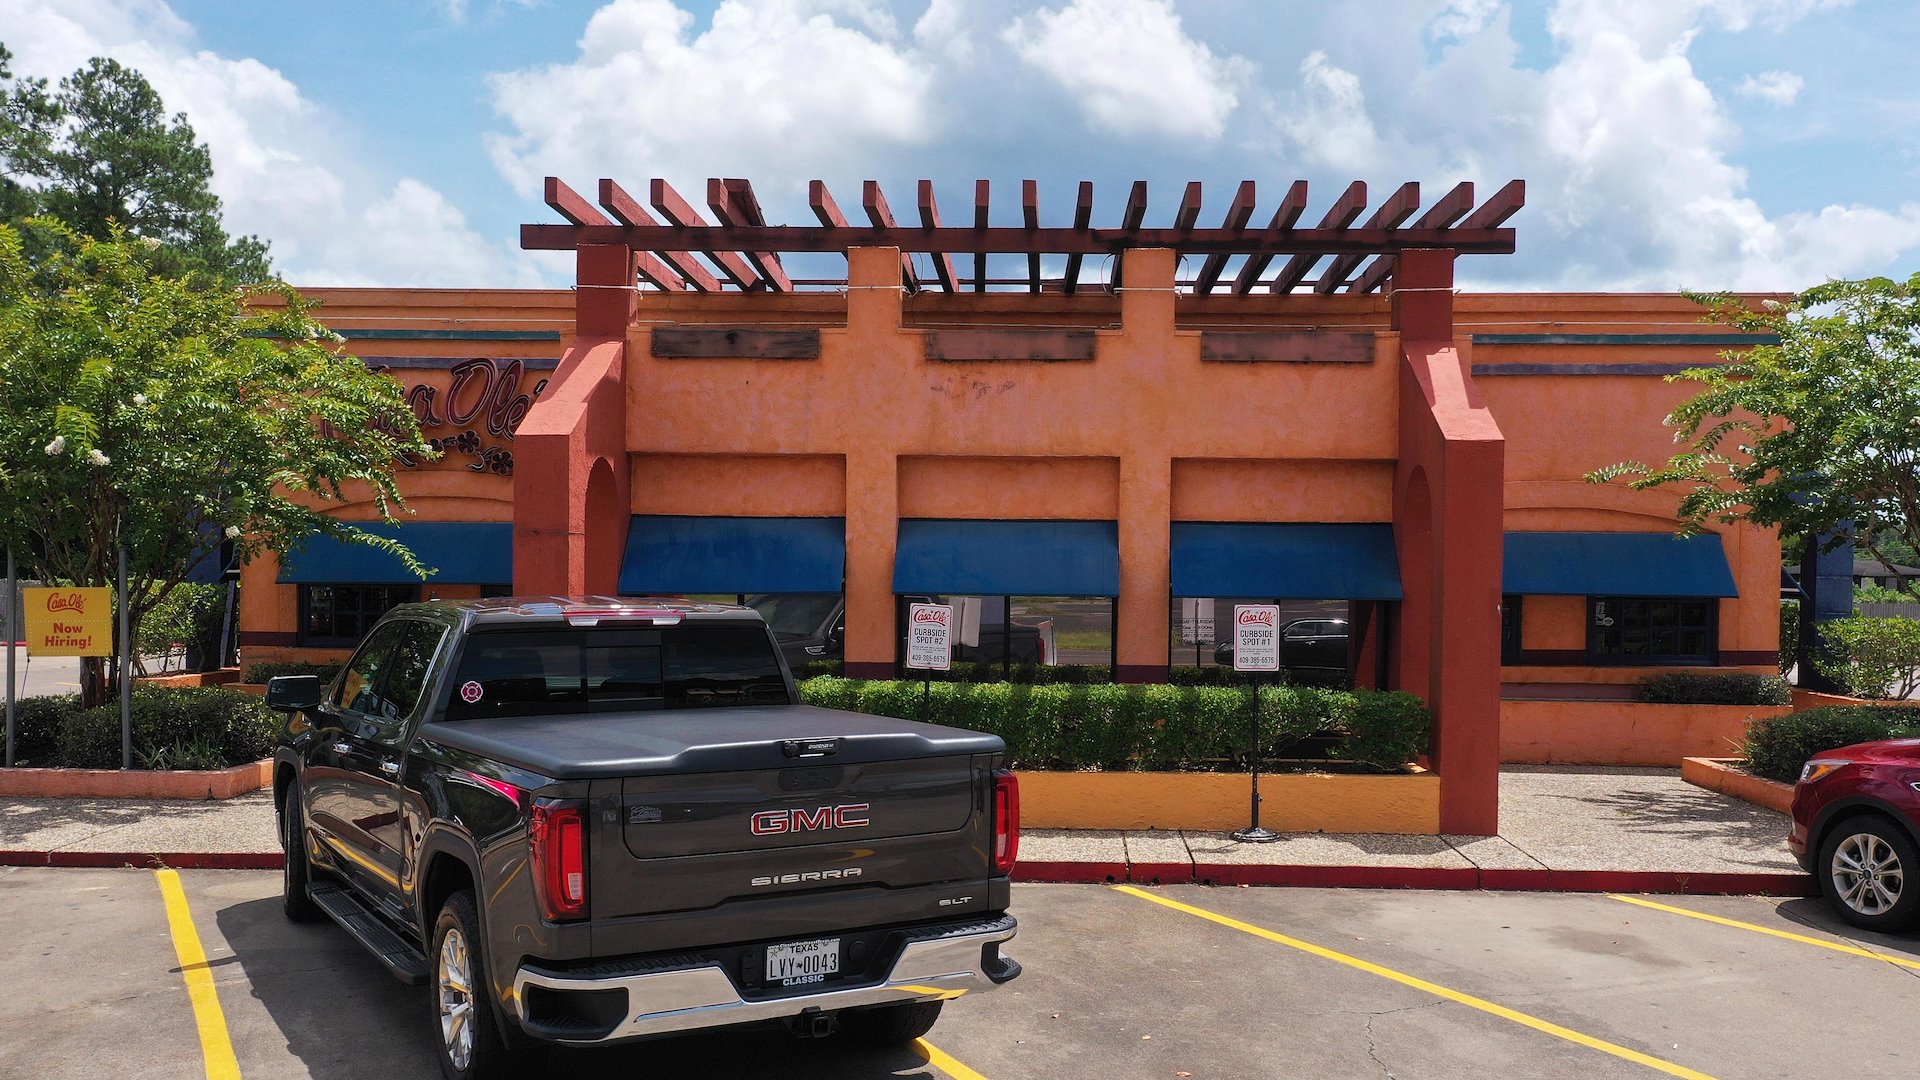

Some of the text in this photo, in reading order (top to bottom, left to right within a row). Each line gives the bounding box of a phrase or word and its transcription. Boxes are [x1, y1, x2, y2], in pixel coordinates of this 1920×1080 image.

[47, 592, 67, 612] Casa
[914, 608, 932, 624] Casa
[1239, 610, 1257, 625] Casa
[53, 622, 83, 633] Now
[914, 627, 947, 637] CURBSIDE
[1240, 629, 1274, 638] CURBSIDE
[45, 635, 92, 649] Hiring!
[916, 636, 944, 645] SPOT #2
[1242, 637, 1270, 646] SPOT #1
[912, 653, 946, 662] 409-385-6575
[1239, 656, 1275, 664] 409-385-6575
[751, 802, 869, 836] GMC
[751, 867, 863, 887] SIERRA
[938, 896, 972, 906] SLT
[790, 943, 819, 954] TEXAS
[782, 974, 825, 986] CLASSIC
